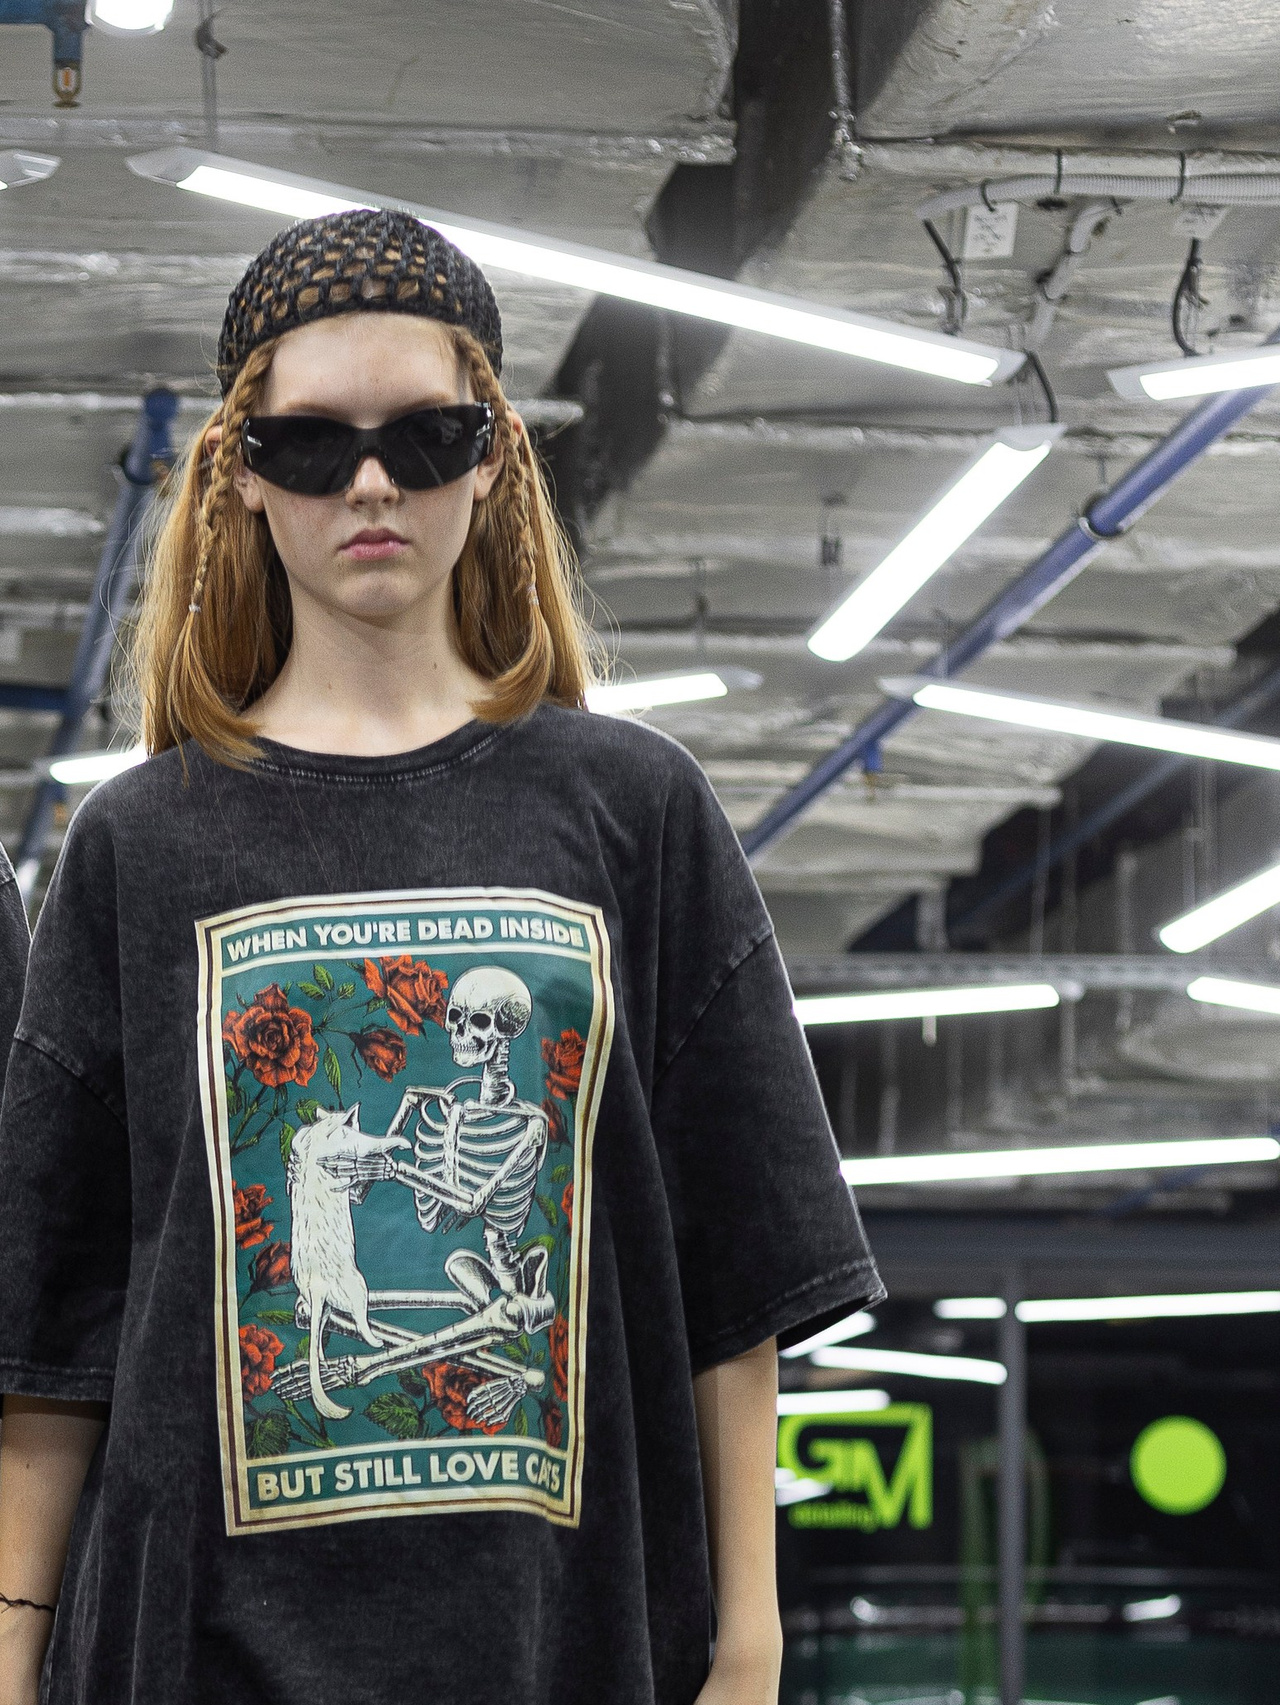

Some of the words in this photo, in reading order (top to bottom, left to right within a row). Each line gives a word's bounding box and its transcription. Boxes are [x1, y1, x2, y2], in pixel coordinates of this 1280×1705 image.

[226, 927, 307, 962] WHEN
[314, 919, 411, 947] YOU'RE
[419, 916, 494, 942] DEAD
[500, 916, 584, 948] INSIDE
[257, 1466, 325, 1501] BUT
[335, 1455, 421, 1492] STILL
[430, 1451, 520, 1484] LOVE
